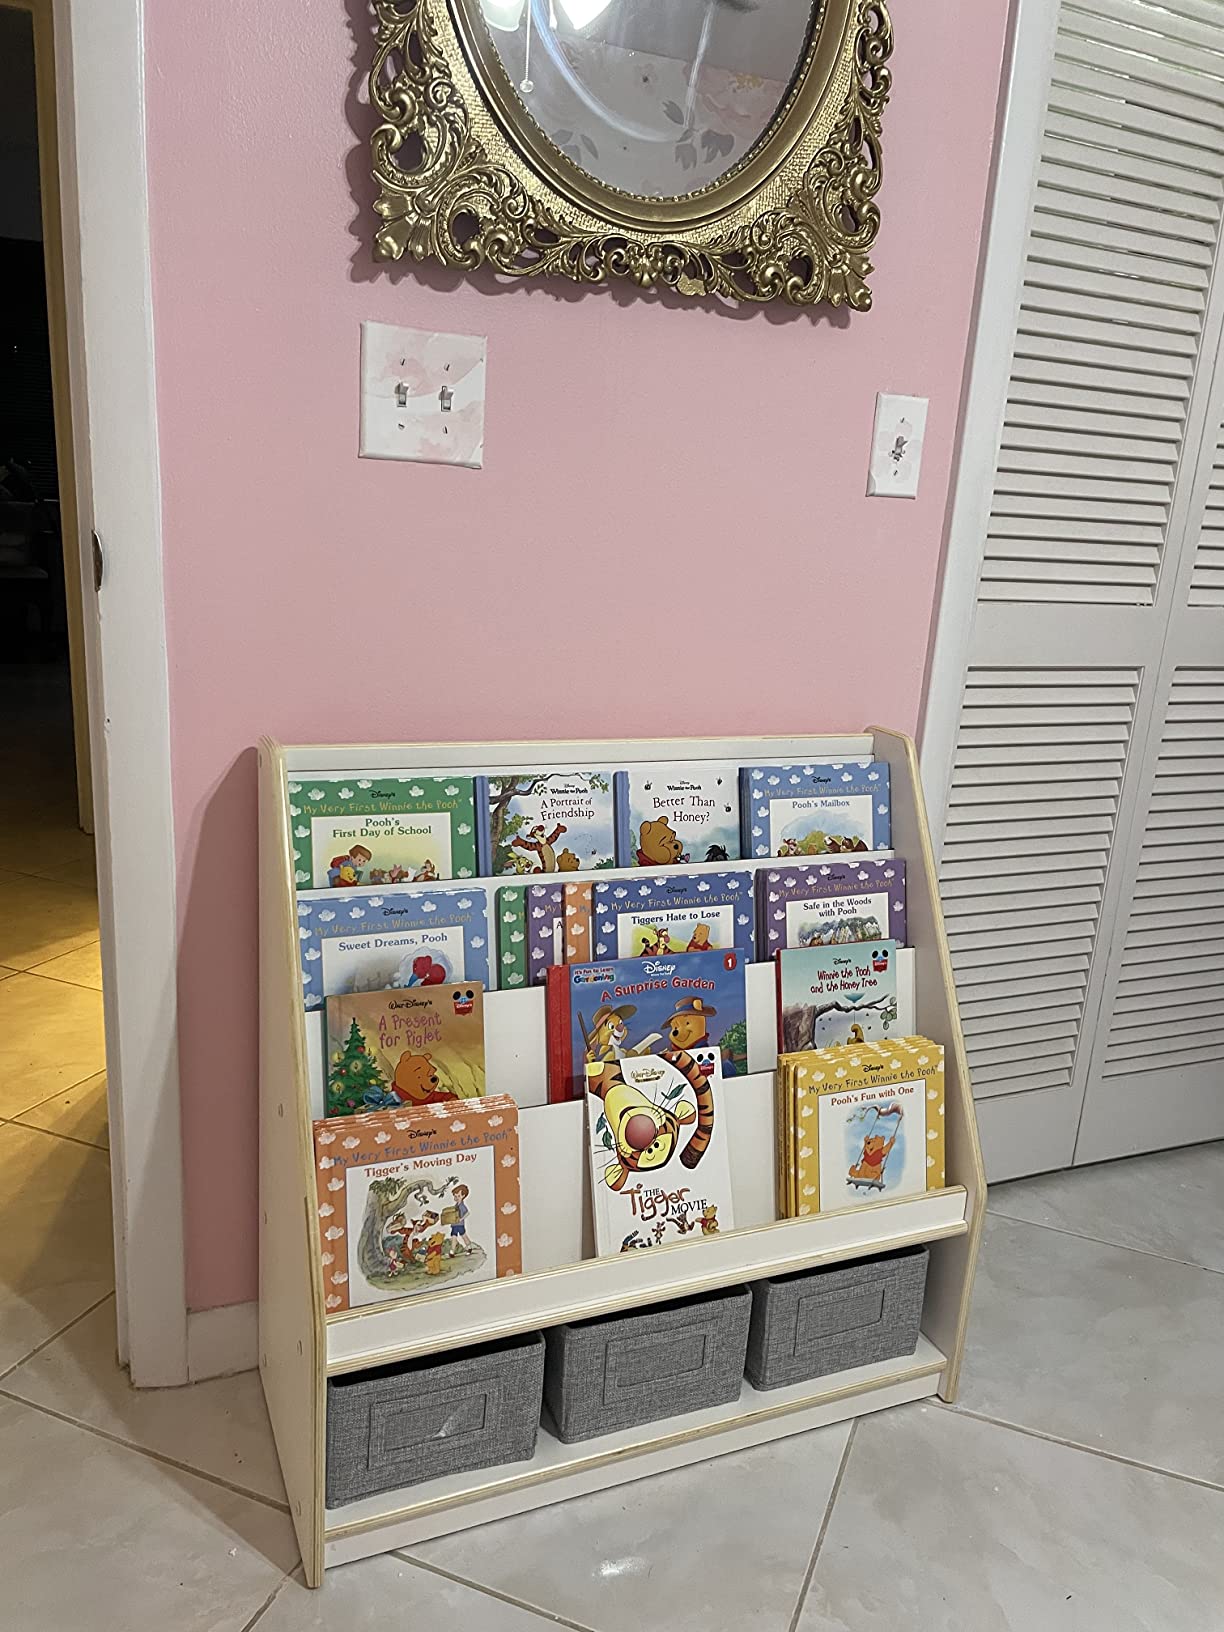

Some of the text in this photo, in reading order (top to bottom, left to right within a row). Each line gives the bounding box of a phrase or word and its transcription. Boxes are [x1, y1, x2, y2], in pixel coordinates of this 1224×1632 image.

[369, 790, 396, 799] Disney's
[764, 789, 774, 797] My
[777, 788, 793, 797] Very
[304, 804, 318, 815] My
[320, 802, 346, 814] Very
[350, 802, 376, 812] First
[380, 801, 412, 811] Winnie
[416, 801, 432, 810] the
[541, 797, 593, 809] A Portrait of
[652, 796, 716, 809] Better Than
[541, 808, 594, 821] Friendship
[673, 811, 710, 824] Honey?
[366, 817, 400, 827] Pooh's
[333, 825, 431, 838] First Day of School
[779, 890, 789, 898] My
[834, 883, 857, 891] Winnie
[861, 881, 874, 889] the
[611, 903, 622, 911] My
[648, 899, 671, 907] First
[674, 896, 701, 905] Winnie
[704, 895, 718, 903] the
[803, 902, 820, 910] Safe
[847, 898, 872, 906] Woods
[382, 908, 409, 917] Disney's
[631, 916, 663, 925] Tiggers
[690, 912, 698, 920] to
[701, 911, 720, 919] Lose
[315, 926, 329, 937] My
[333, 923, 357, 935] Very
[360, 921, 388, 931] First
[392, 919, 425, 929] Winnie
[429, 916, 446, 925] the
[338, 932, 447, 951] Sweet Dreams, Pooh
[818, 965, 870, 980] Winnie the Pooh
[601, 976, 715, 1002] A Surprise Garden
[810, 978, 877, 993] and the Honey Tree
[379, 1012, 442, 1030] A Present
[380, 1028, 442, 1049] for Piglet
[809, 1086, 820, 1094] My
[823, 1083, 842, 1091] Very
[846, 1079, 868, 1088] First
[871, 1075, 897, 1083] Winnie
[831, 1096, 858, 1105] Pooh's
[407, 1129, 437, 1139] Disney's
[334, 1155, 348, 1166] My
[352, 1152, 379, 1162] Very
[384, 1146, 415, 1157] First
[419, 1141, 456, 1153] Winnie
[461, 1136, 480, 1146] the
[364, 1152, 477, 1178] Tigger's Moving Day
[644, 1188, 660, 1197] THE
[620, 1183, 690, 1221] Tigger
[671, 1199, 707, 1215] MOVIE
